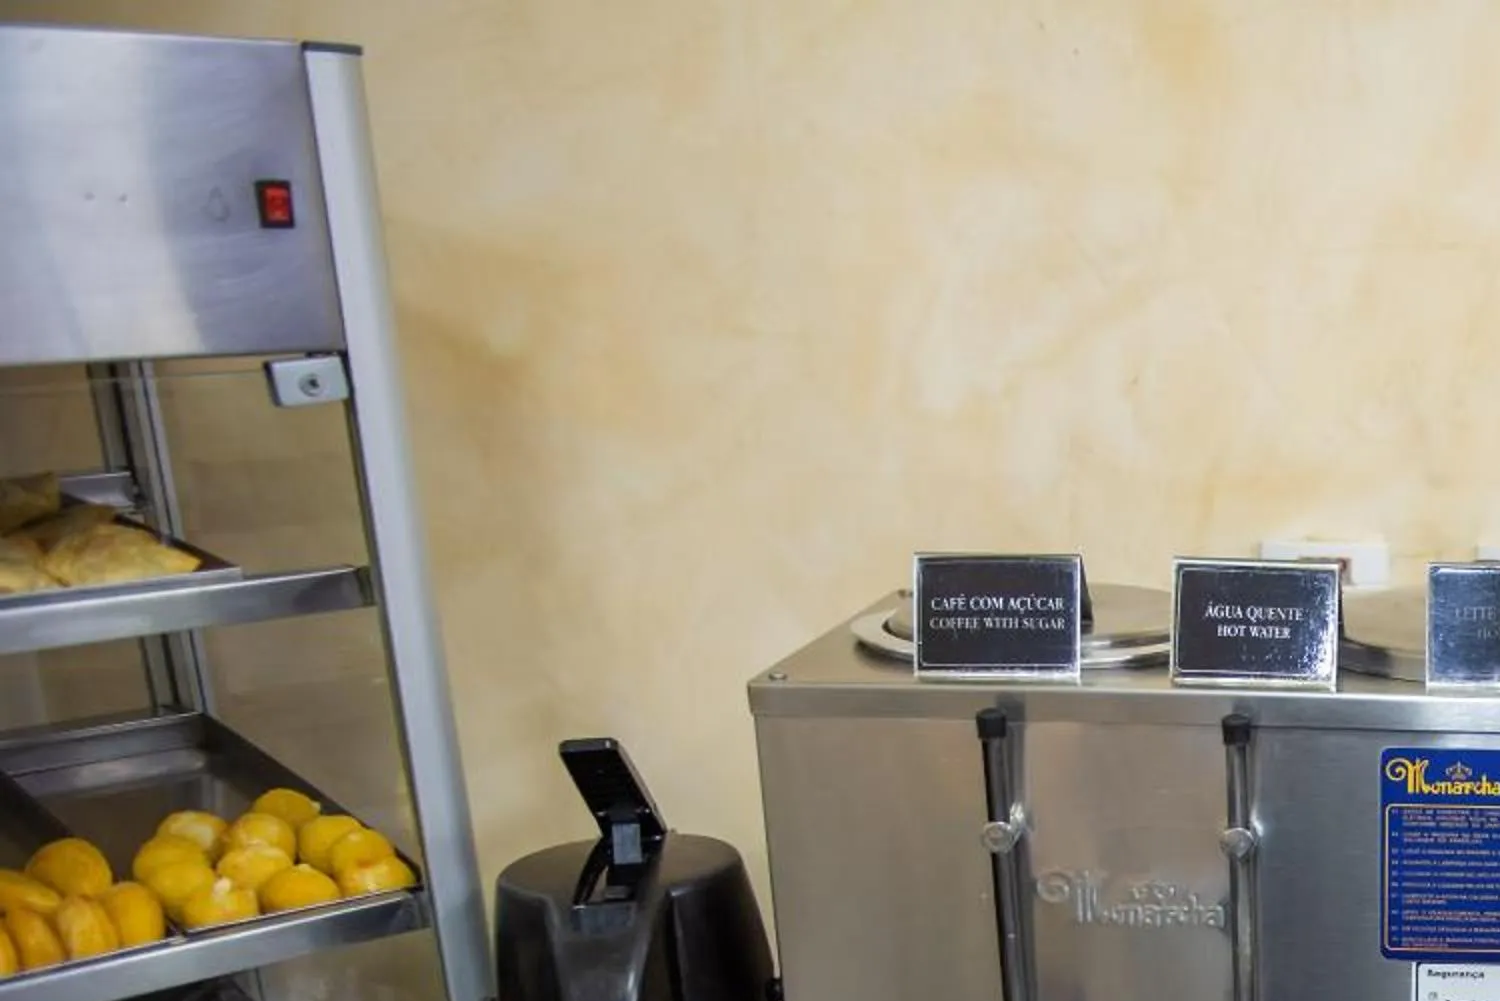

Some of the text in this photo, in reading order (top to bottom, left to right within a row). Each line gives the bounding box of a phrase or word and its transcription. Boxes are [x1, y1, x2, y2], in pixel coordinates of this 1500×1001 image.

[931, 593, 967, 611] CAFÉ
[970, 596, 1004, 611] COM
[1205, 601, 1305, 623] ÁGUA QUENTE
[929, 617, 1066, 630] COFFEE WITH SUGAR
[1217, 625, 1292, 639] HOT WATER
